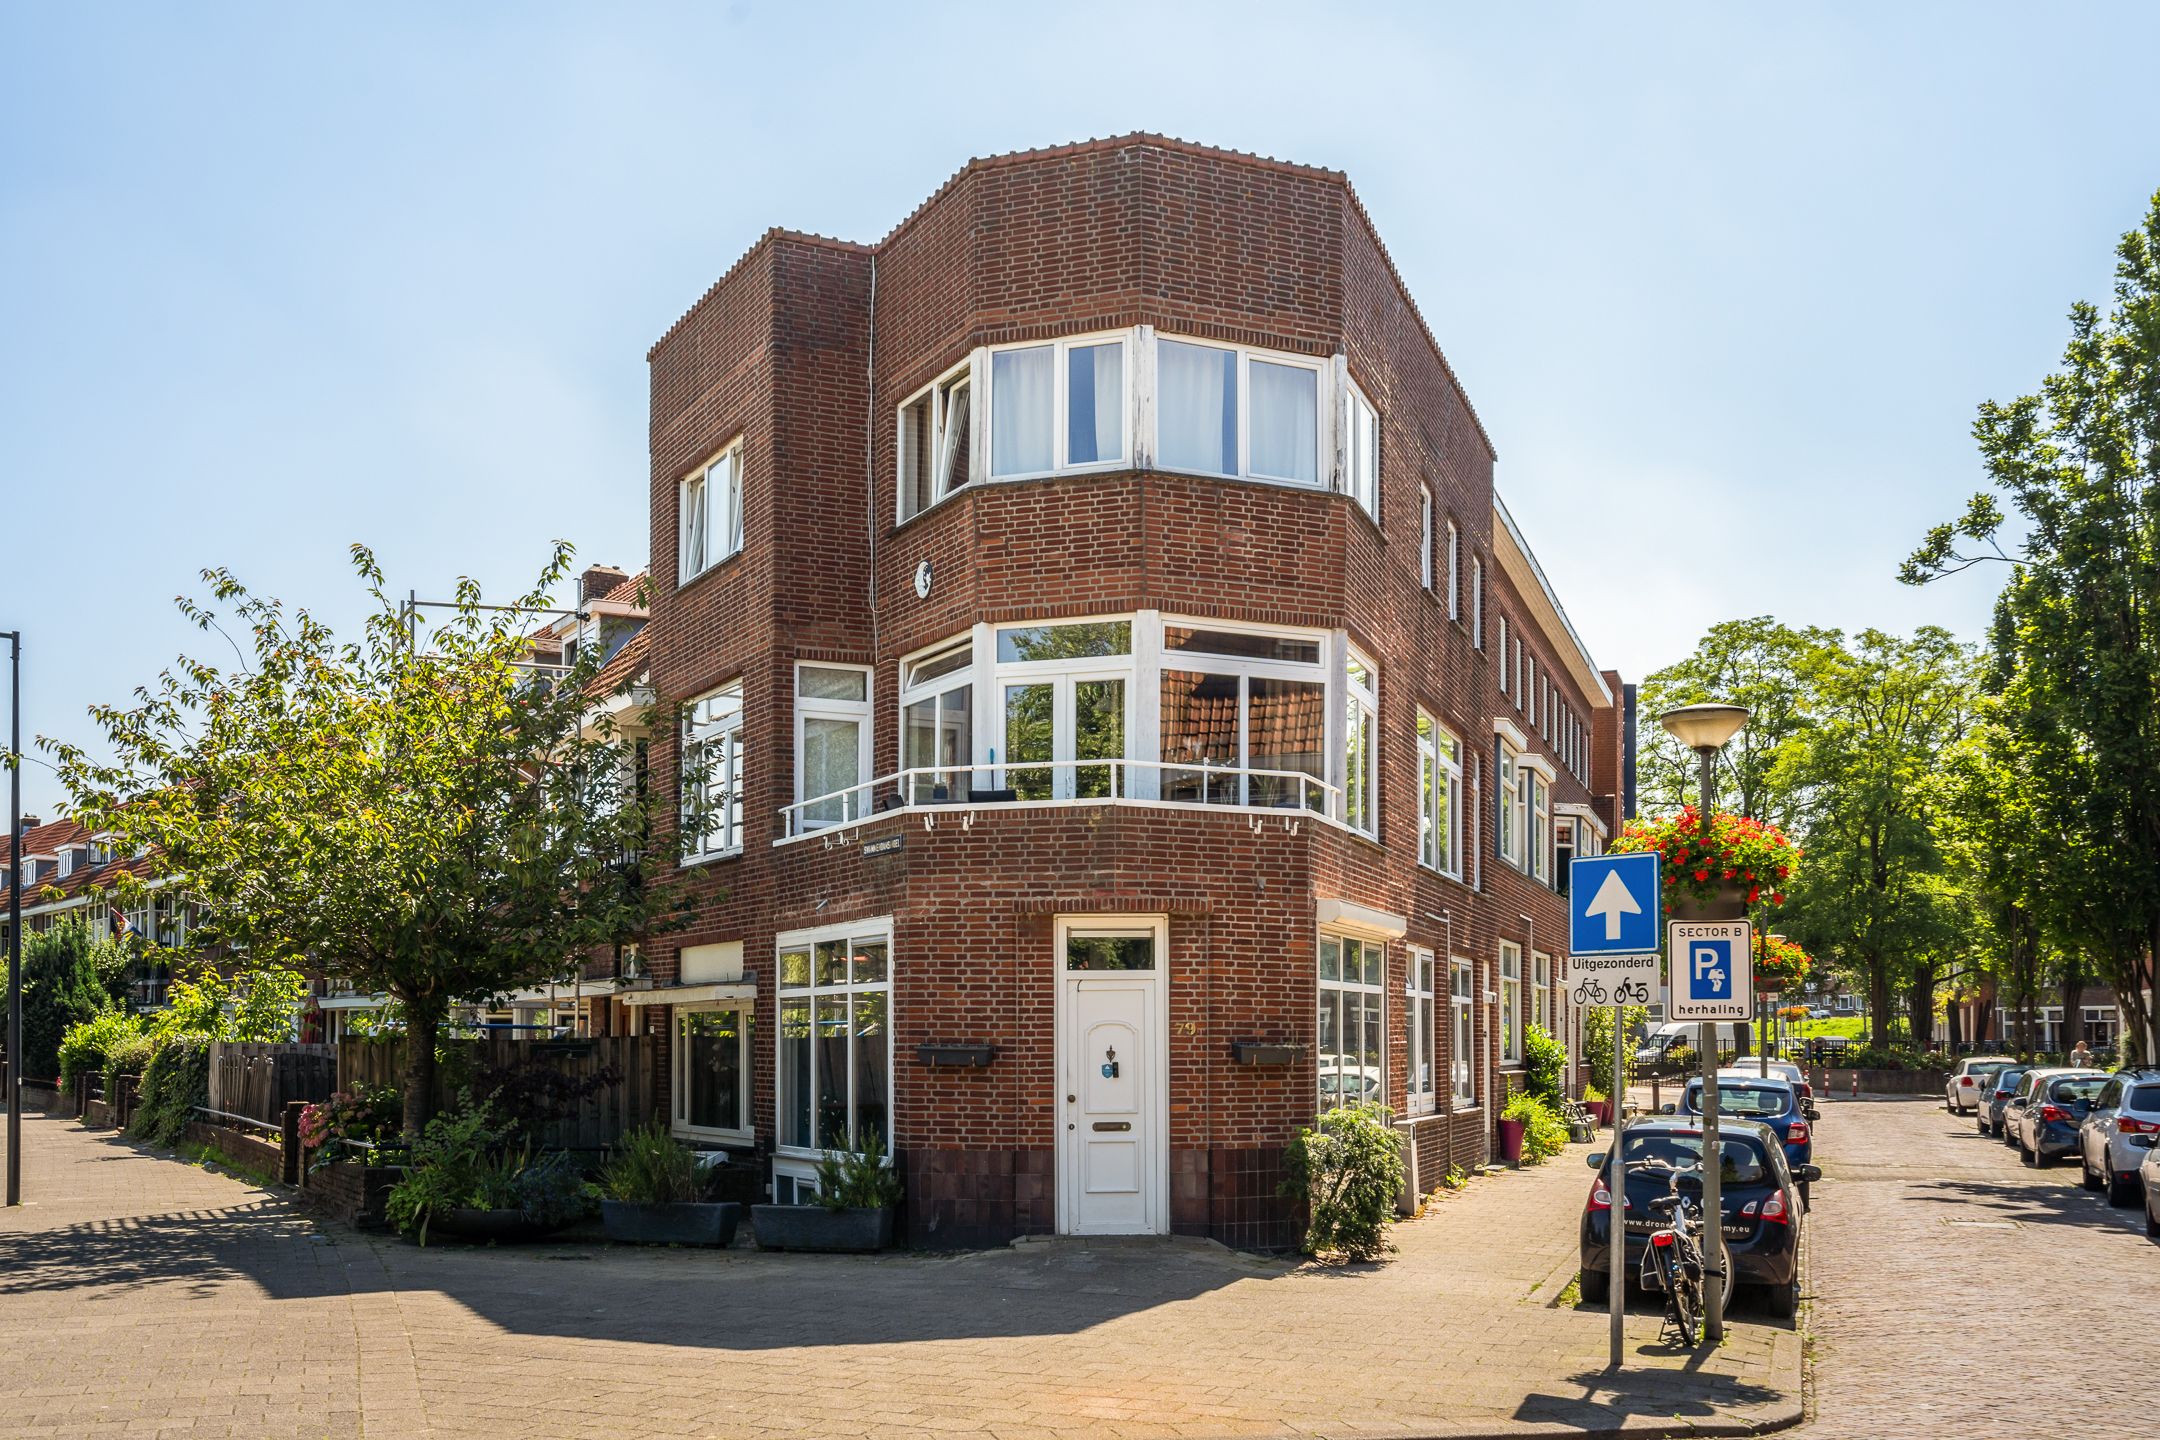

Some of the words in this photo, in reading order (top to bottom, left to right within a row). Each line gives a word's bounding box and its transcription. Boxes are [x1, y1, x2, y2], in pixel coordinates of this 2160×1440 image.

[1678, 927, 1729, 937] SECTOR
[1734, 927, 1742, 937] B
[1573, 956, 1653, 972] Uitgezonderd
[1695, 948, 1719, 980] P
[1679, 1004, 1744, 1017] herhaling
[1174, 1022, 1196, 1036] 79
